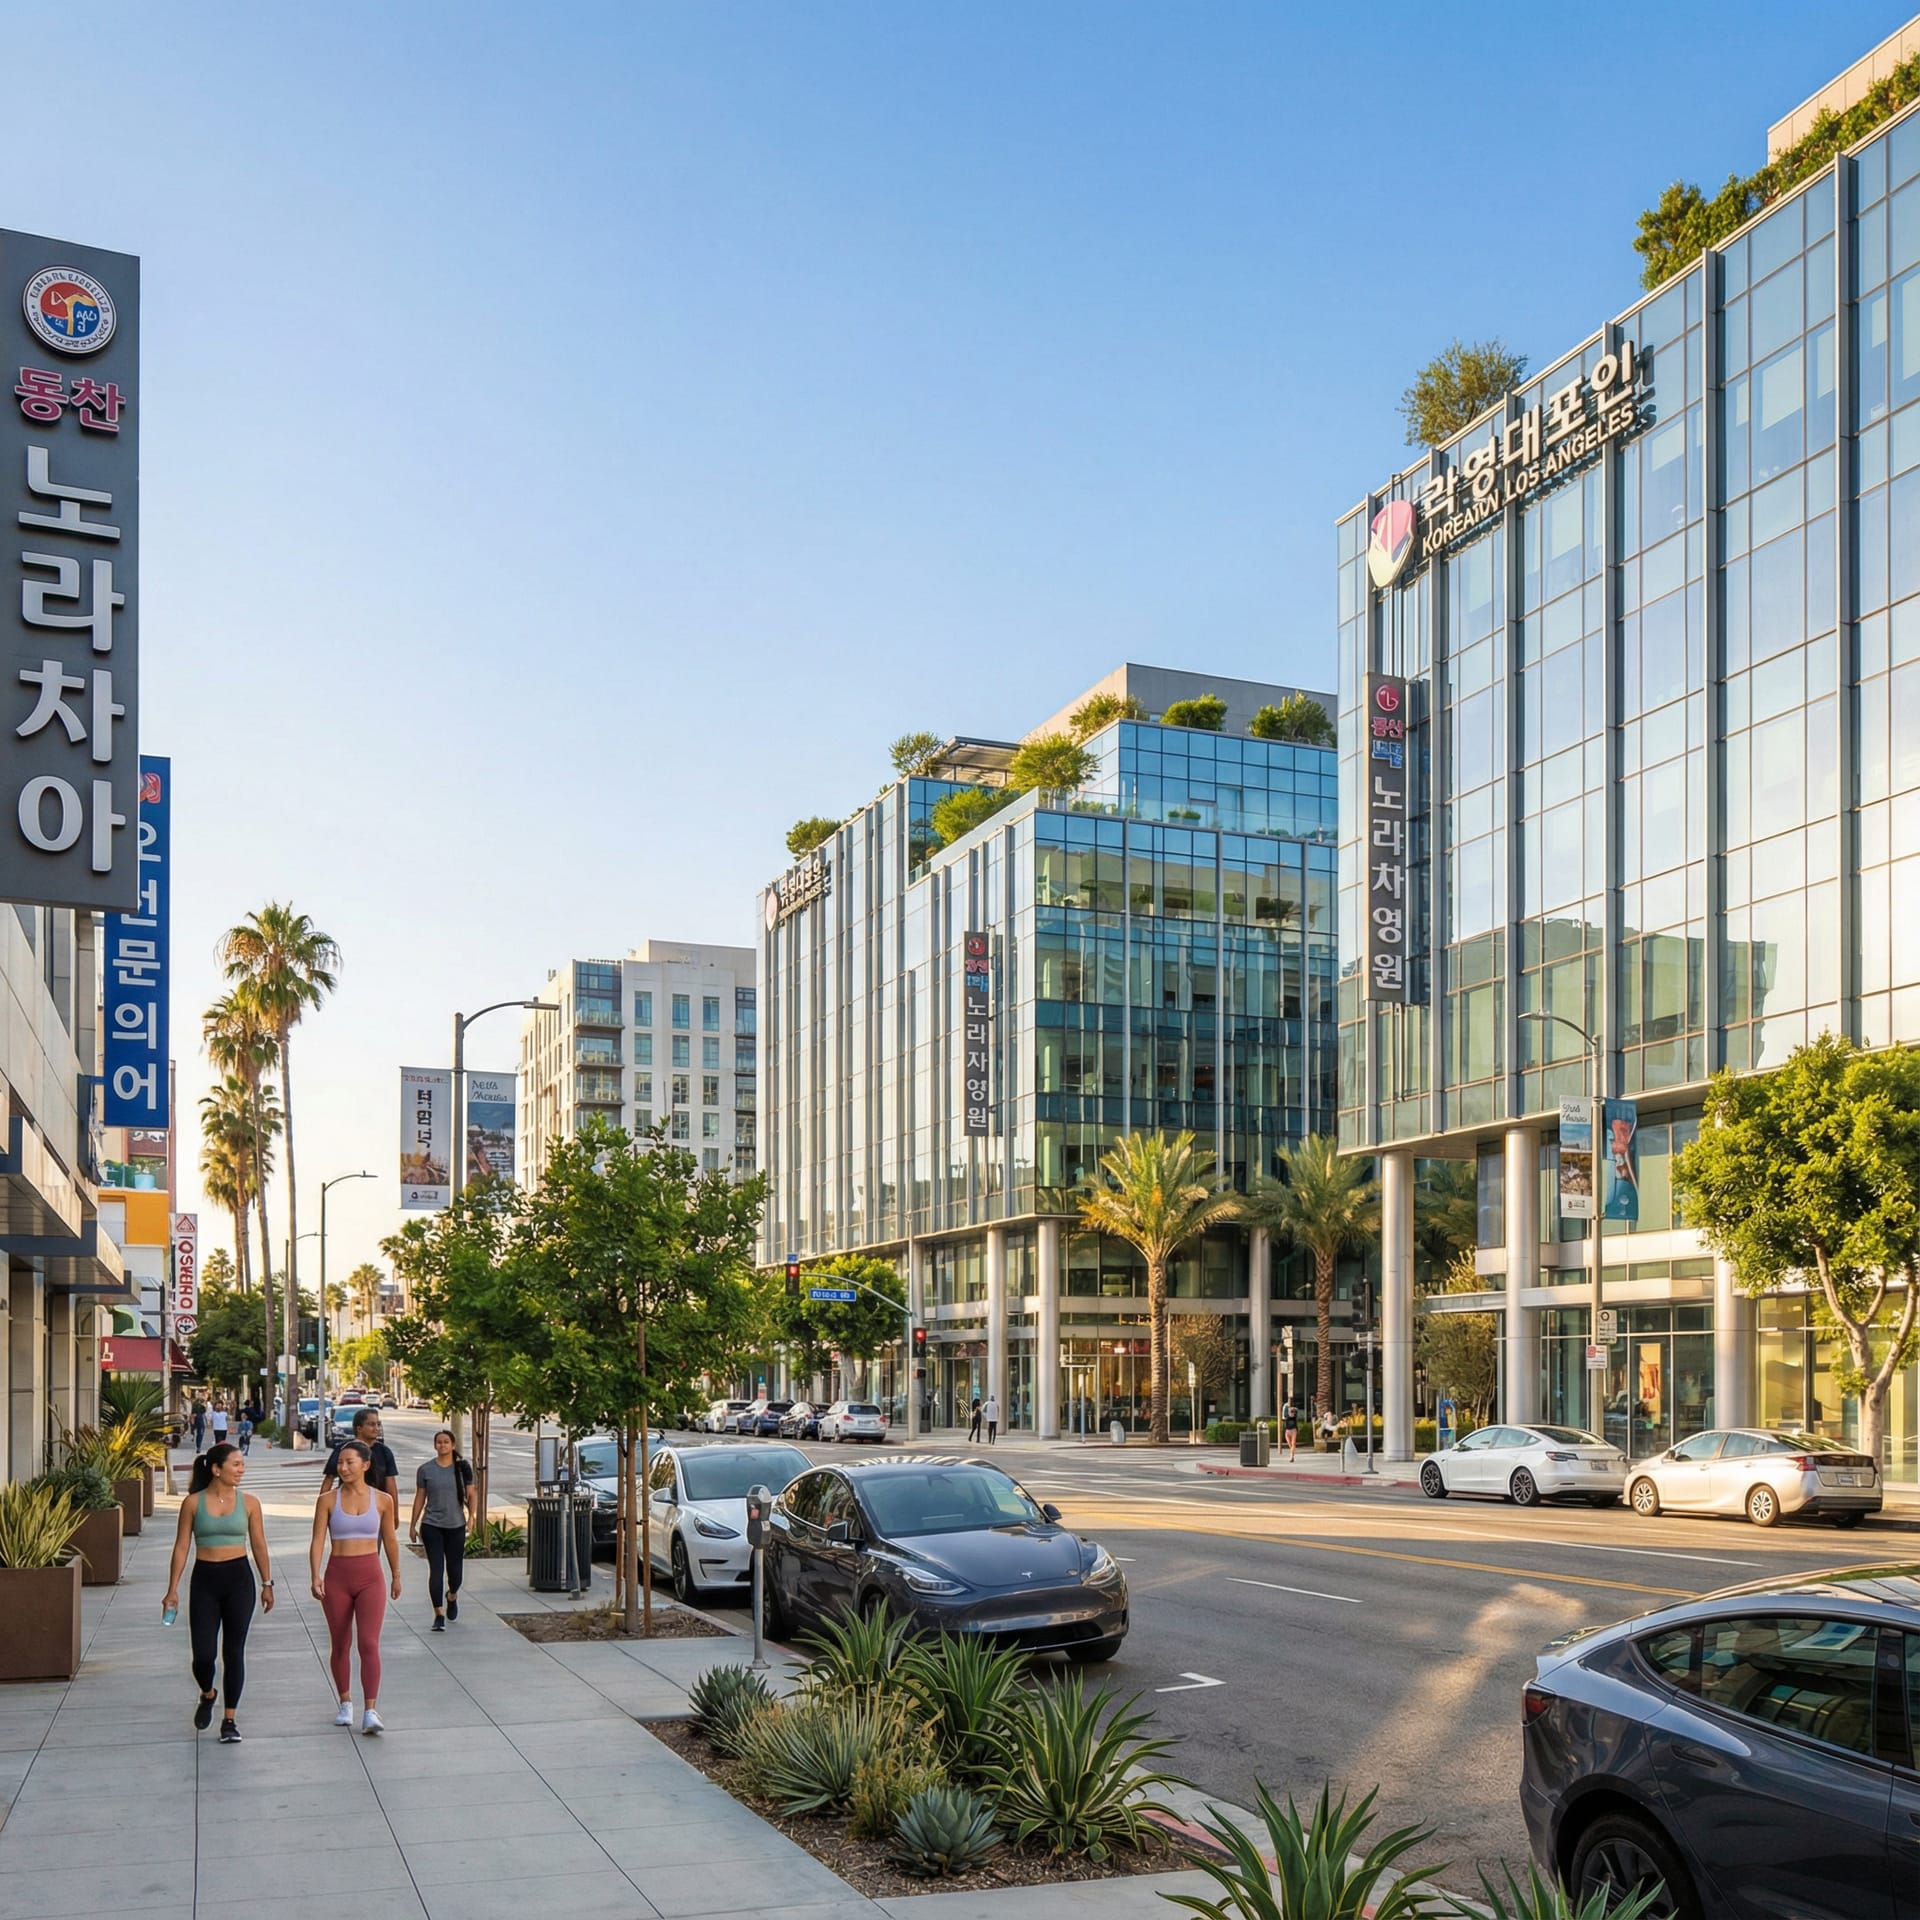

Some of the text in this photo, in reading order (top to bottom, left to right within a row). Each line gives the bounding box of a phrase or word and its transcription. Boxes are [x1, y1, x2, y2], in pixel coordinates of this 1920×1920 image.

[14, 366, 126, 432] 동찬
[1504, 464, 1540, 502] LOS
[1544, 402, 1635, 478] ANGELES
[16, 445, 126, 872] 노라차아
